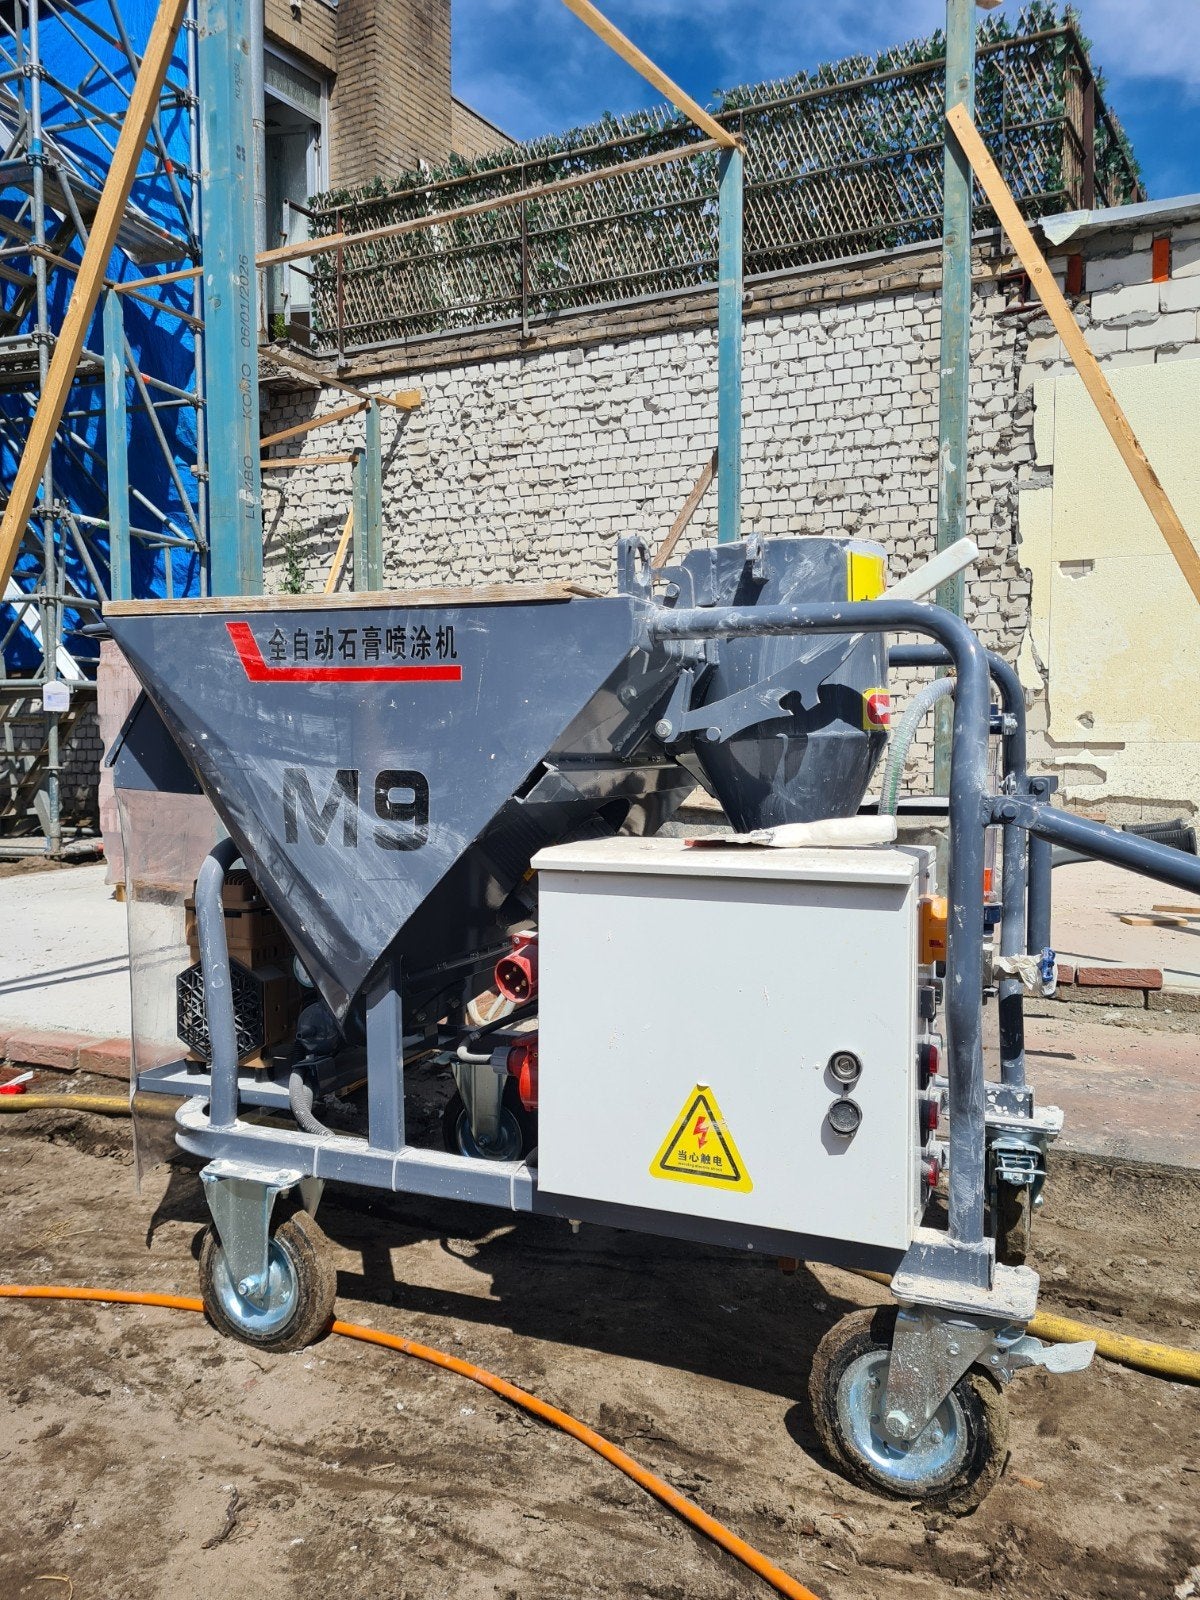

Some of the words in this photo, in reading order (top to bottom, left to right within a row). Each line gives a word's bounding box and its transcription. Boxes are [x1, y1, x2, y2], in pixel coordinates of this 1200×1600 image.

[239, 254, 251, 348] 06/01/2026
[241, 363, 252, 419] KOMO
[268, 624, 458, 661] 全自动石膏喷涂机
[283, 767, 430, 851] M9
[677, 1149, 723, 1167] 当心触电
